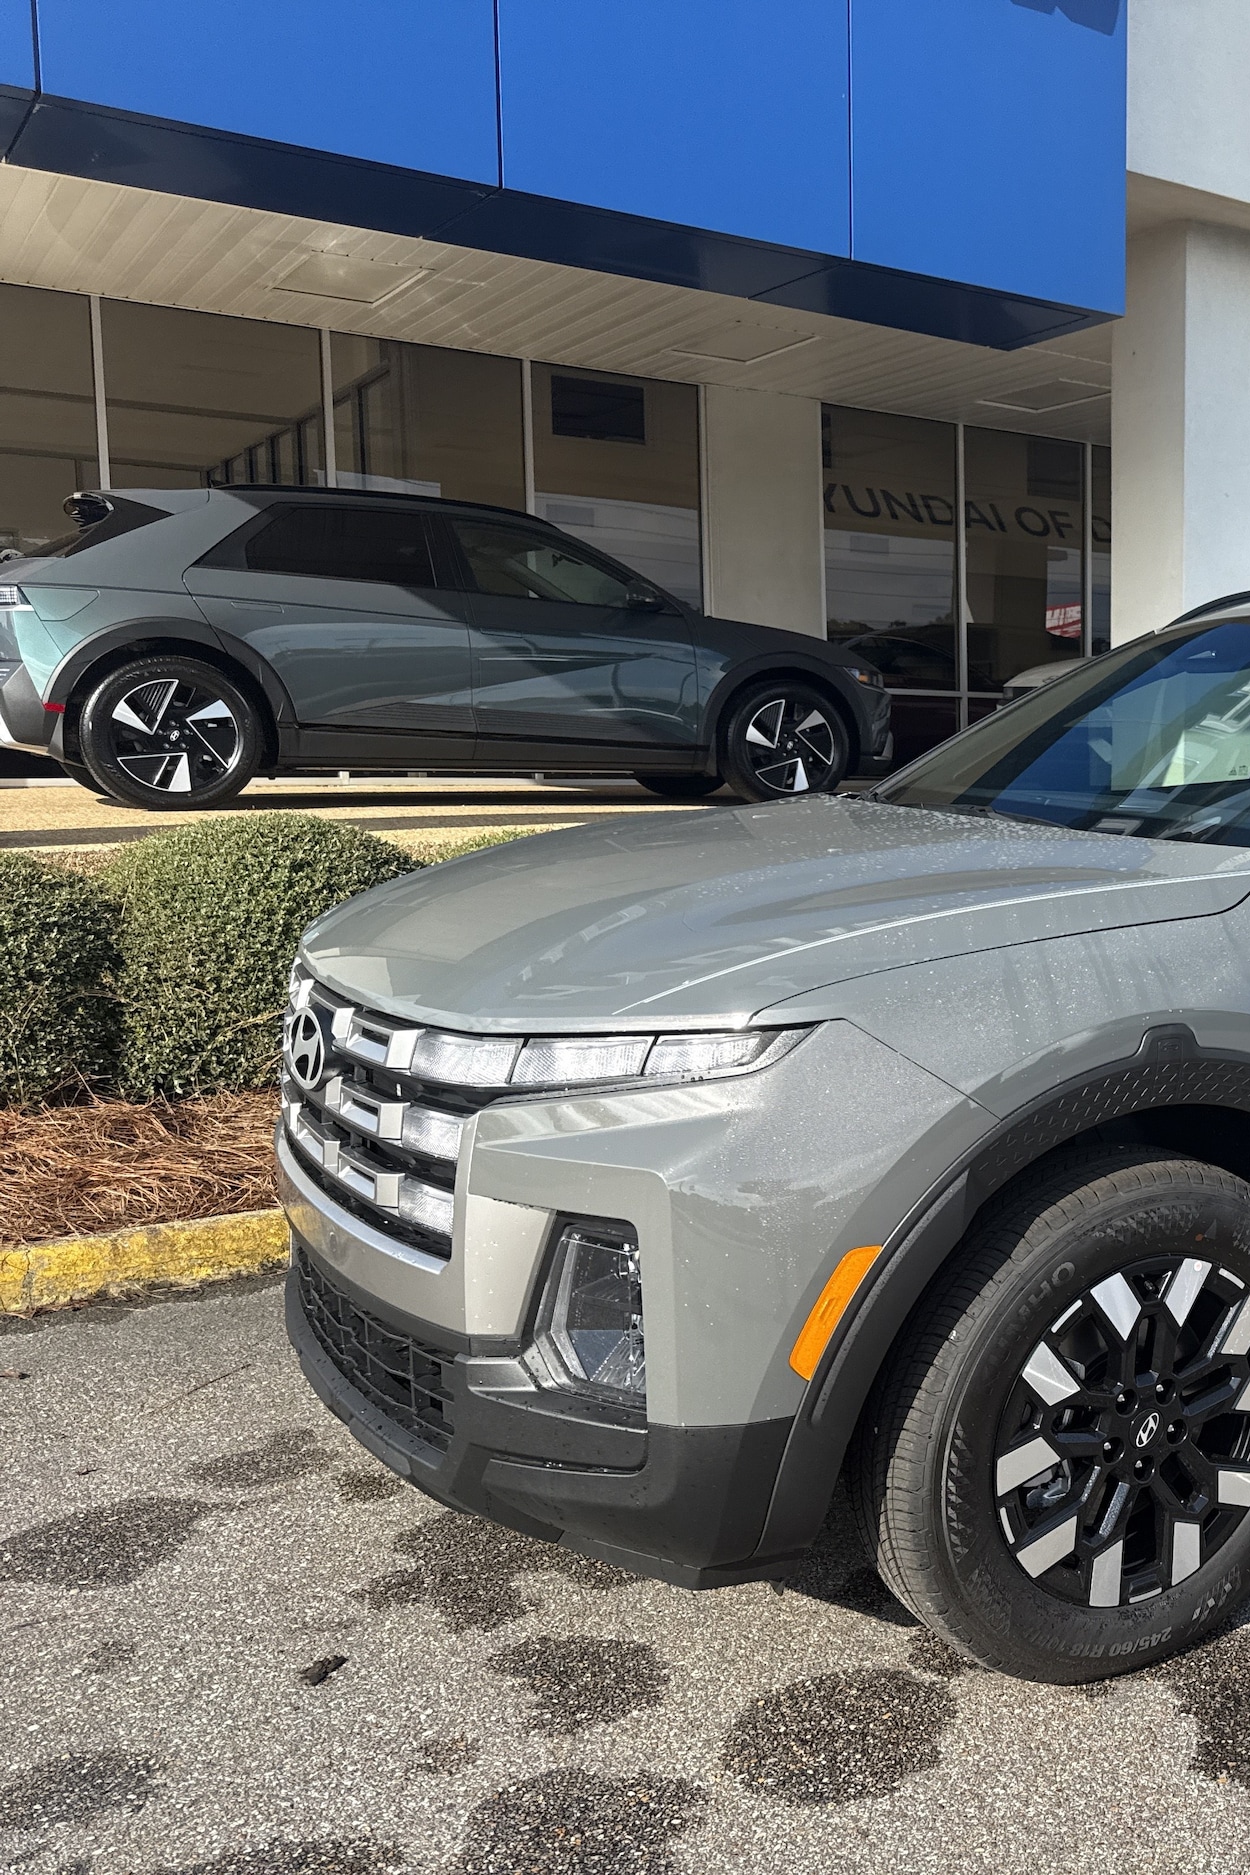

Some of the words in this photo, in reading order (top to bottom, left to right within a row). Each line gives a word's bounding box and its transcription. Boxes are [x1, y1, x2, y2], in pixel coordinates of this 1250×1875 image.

[1014, 506, 1074, 539] OF
[1069, 1642, 1105, 1658] R18
[1108, 1626, 1173, 1658] 245/60
